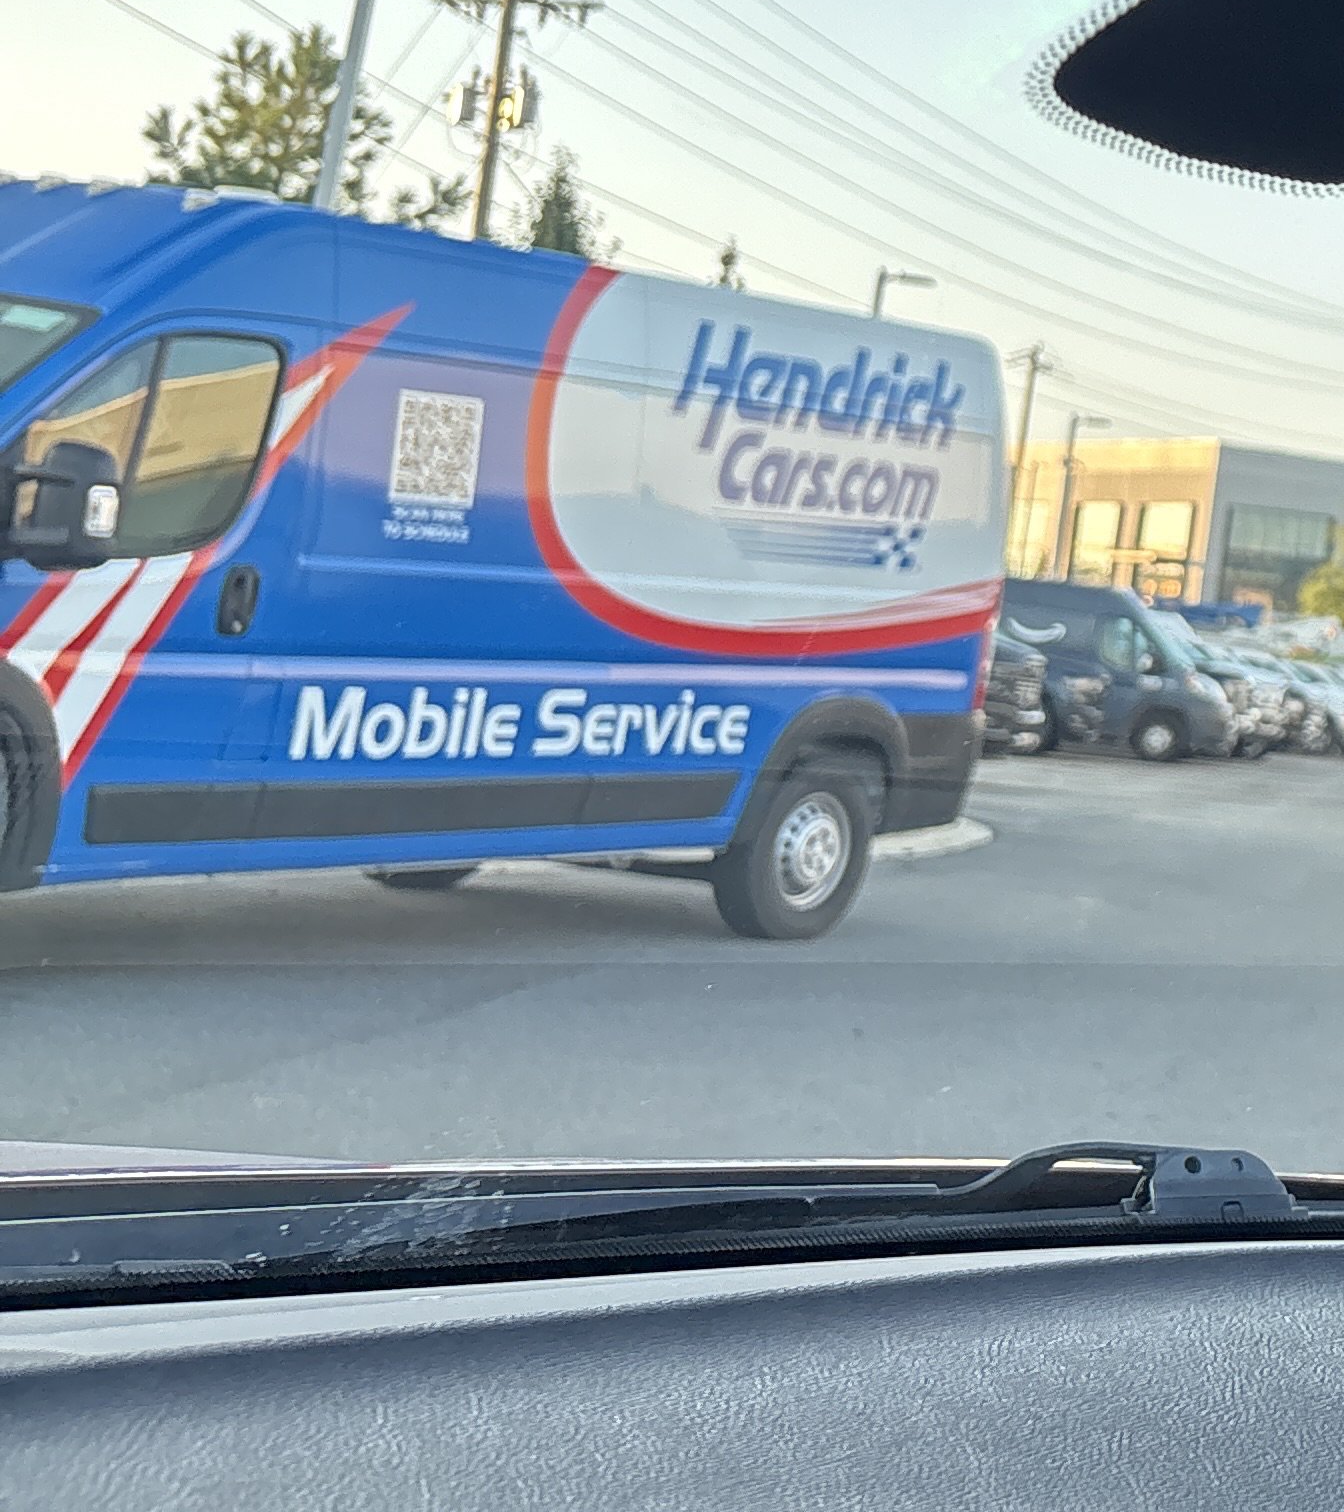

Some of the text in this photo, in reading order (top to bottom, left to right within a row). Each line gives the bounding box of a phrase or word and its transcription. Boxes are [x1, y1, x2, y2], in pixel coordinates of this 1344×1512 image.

[672, 319, 964, 449] Hendrick
[718, 431, 941, 520] Cars.com
[289, 686, 751, 761] Mobile Service
